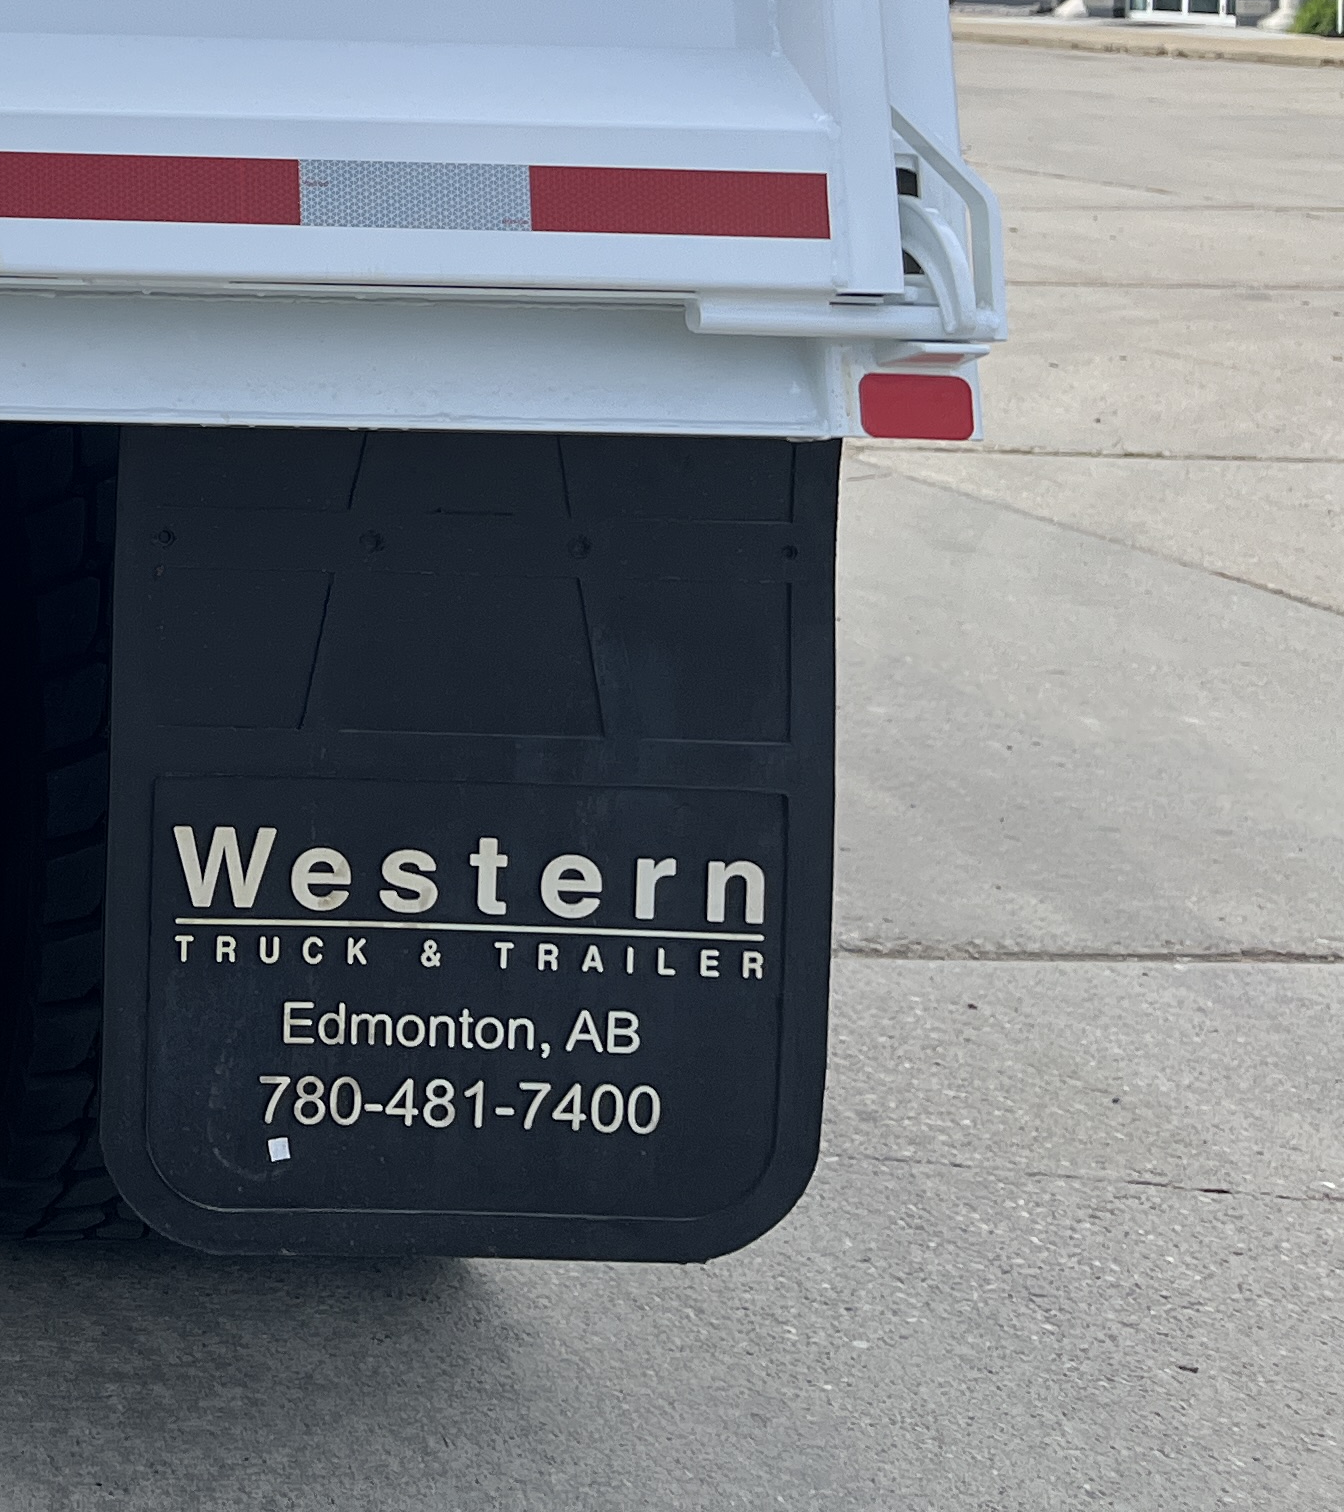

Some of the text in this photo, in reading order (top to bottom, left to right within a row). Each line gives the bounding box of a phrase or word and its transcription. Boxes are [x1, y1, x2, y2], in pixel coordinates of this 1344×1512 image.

[173, 825, 766, 926] Western
[174, 935, 764, 980] TRUCK & TRAILER
[282, 1001, 641, 1058] Edmonton, AB
[258, 1074, 662, 1136] 780-481-7400
